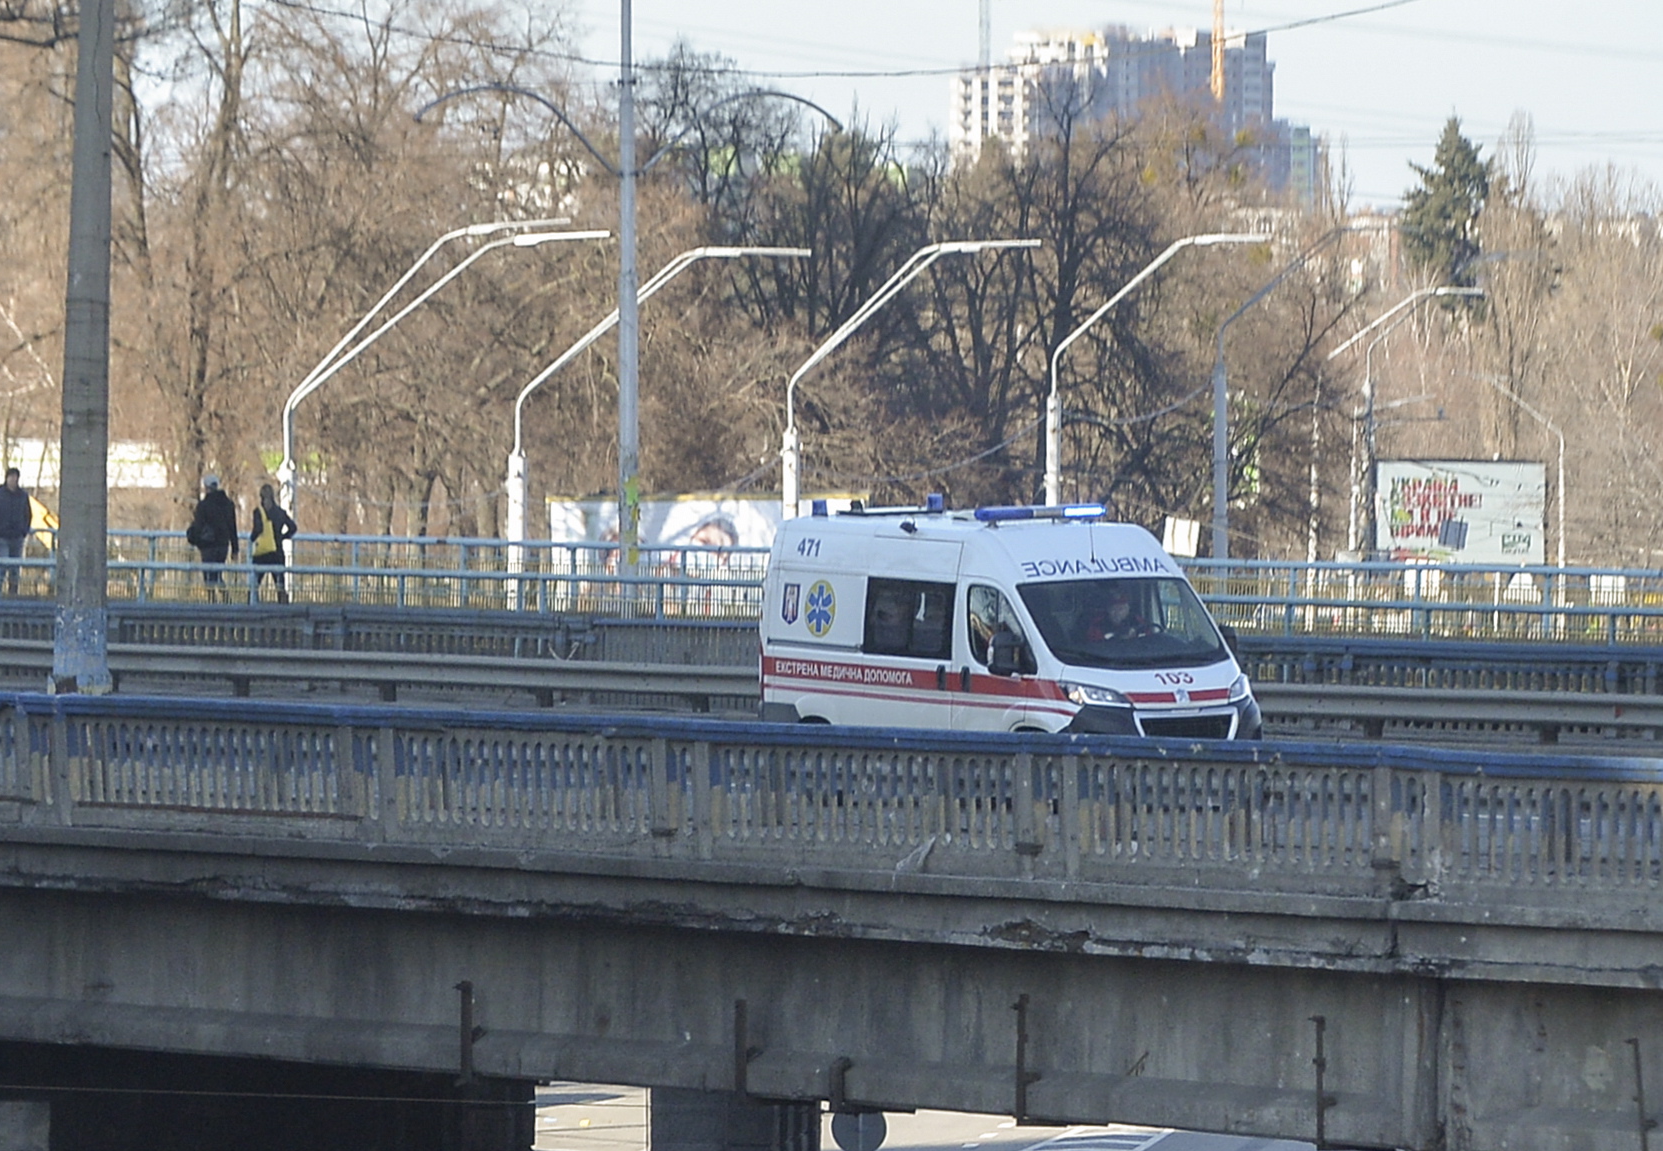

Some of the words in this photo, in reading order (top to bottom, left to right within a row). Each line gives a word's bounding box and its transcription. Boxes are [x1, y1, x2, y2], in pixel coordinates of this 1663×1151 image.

[797, 537, 822, 557] 471
[775, 660, 819, 677] ЕКСТРЕНА
[820, 664, 863, 681] МЕДИЧНА
[863, 668, 914, 685] ДОПОМОГА
[1154, 671, 1195, 686] 103
